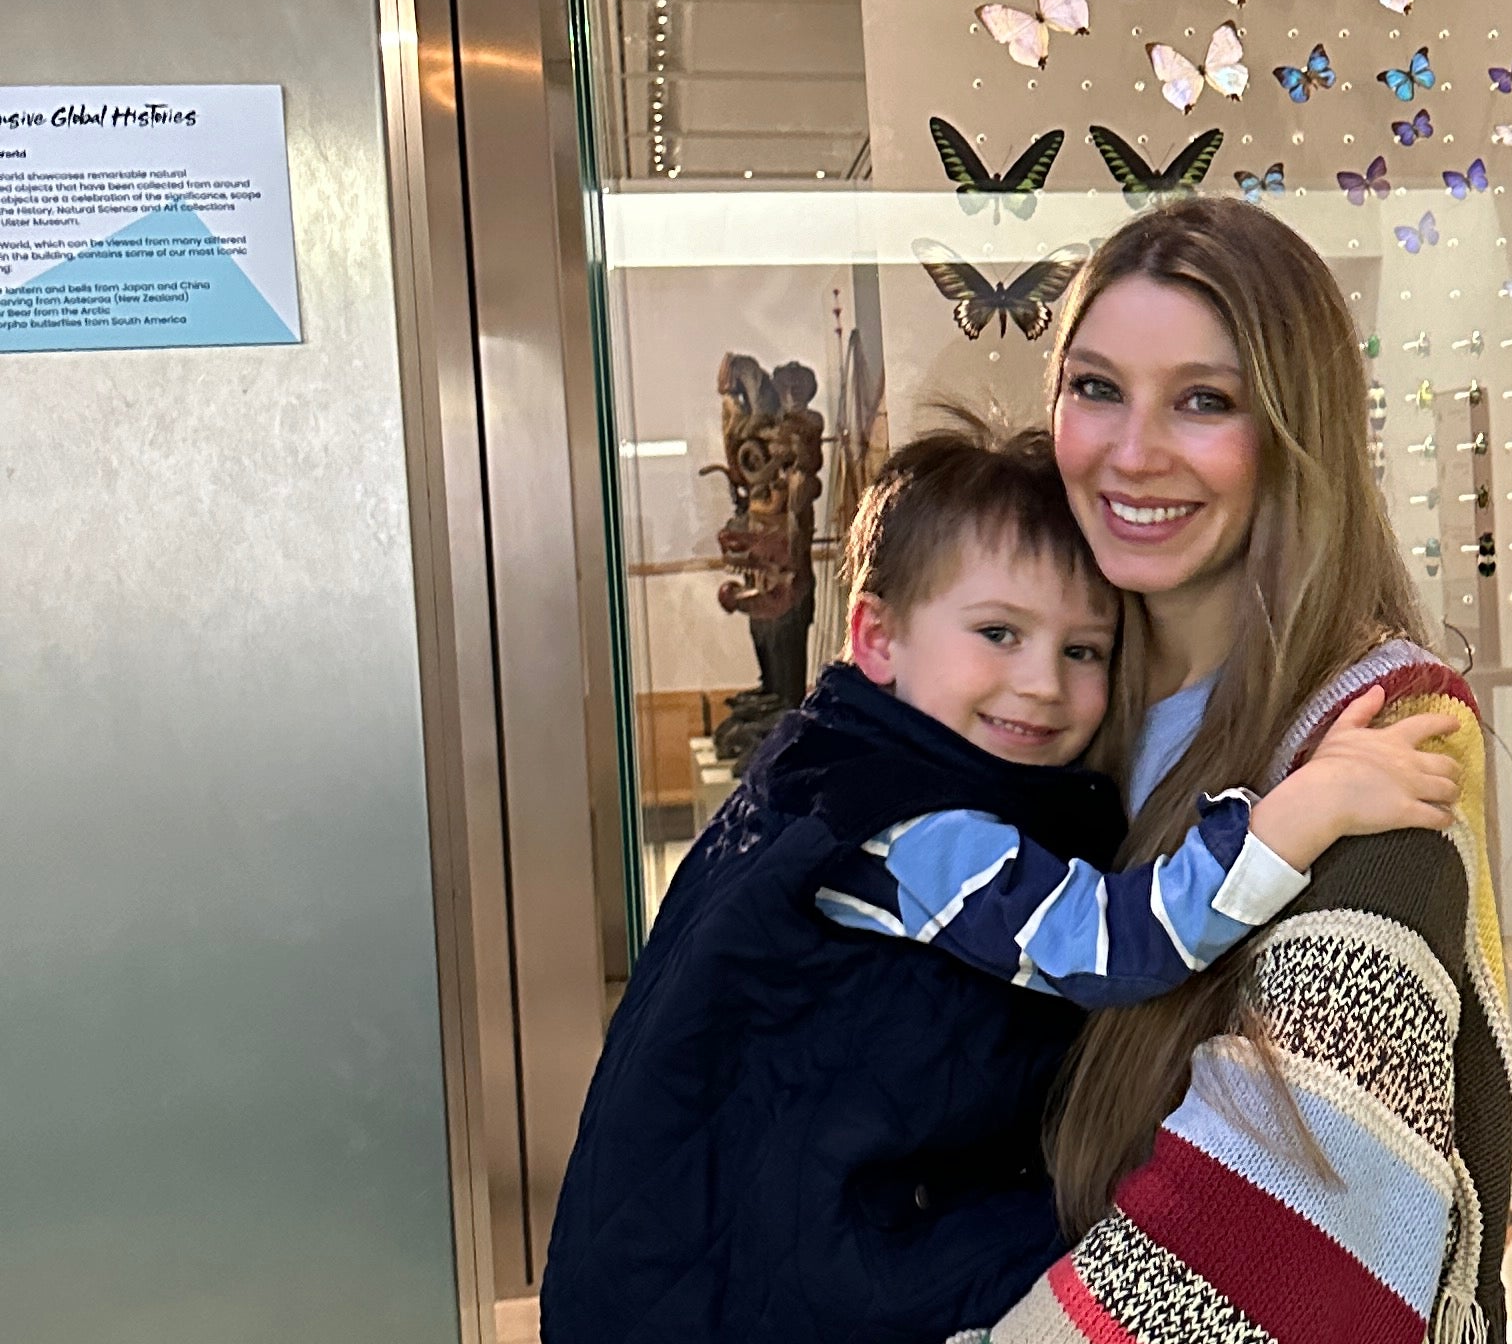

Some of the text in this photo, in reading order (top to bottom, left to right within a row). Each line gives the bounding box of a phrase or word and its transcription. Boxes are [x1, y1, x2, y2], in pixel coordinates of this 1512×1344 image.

[51, 104, 107, 127] Global
[27, 172, 84, 181] showcases
[87, 170, 147, 179] remarkable
[149, 169, 187, 178] natural
[15, 183, 53, 194] objects
[56, 183, 77, 191] that
[80, 182, 105, 191] have
[108, 181, 134, 190] been
[136, 180, 184, 190] collected
[187, 179, 211, 189] from
[213, 179, 250, 188] around
[1, 195, 39, 206] objects
[71, 193, 130, 203] celebration
[132, 192, 142, 201] of
[145, 192, 161, 201] the
[230, 191, 261, 202] scope
[57, 204, 95, 214] Natural
[98, 204, 138, 213] Science
[141, 203, 161, 212] and
[164, 203, 178, 212] Art
[180, 202, 235, 212] collections
[1, 218, 30, 227] Ulster
[34, 239, 65, 248] which
[67, 239, 87, 248] can
[90, 238, 104, 247] be
[106, 237, 142, 247] viewed
[145, 236, 169, 246] from
[172, 237, 202, 247] many
[204, 235, 247, 244] different
[12, 251, 28, 260] the
[77, 250, 122, 259] contains
[125, 250, 154, 258] some
[157, 248, 167, 257] of
[169, 249, 187, 257] our
[189, 247, 215, 256] most
[217, 246, 247, 256] iconic
[5, 286, 42, 294] lantern
[45, 285, 66, 294] and
[68, 284, 92, 293] bells
[95, 284, 119, 293] from
[122, 283, 155, 293] Japan
[157, 282, 178, 291] and
[180, 281, 210, 290] China
[36, 296, 61, 305] from
[64, 296, 111, 305] Aotearoa
[114, 293, 140, 304] (New
[143, 292, 189, 303] Zealand)
[7, 309, 31, 317] Bear
[34, 307, 59, 316] from
[61, 307, 78, 316] the
[81, 306, 110, 315] Arctic
[30, 319, 82, 328] butterflies
[85, 317, 110, 327] from
[111, 316, 141, 326] South
[143, 315, 187, 325] America
